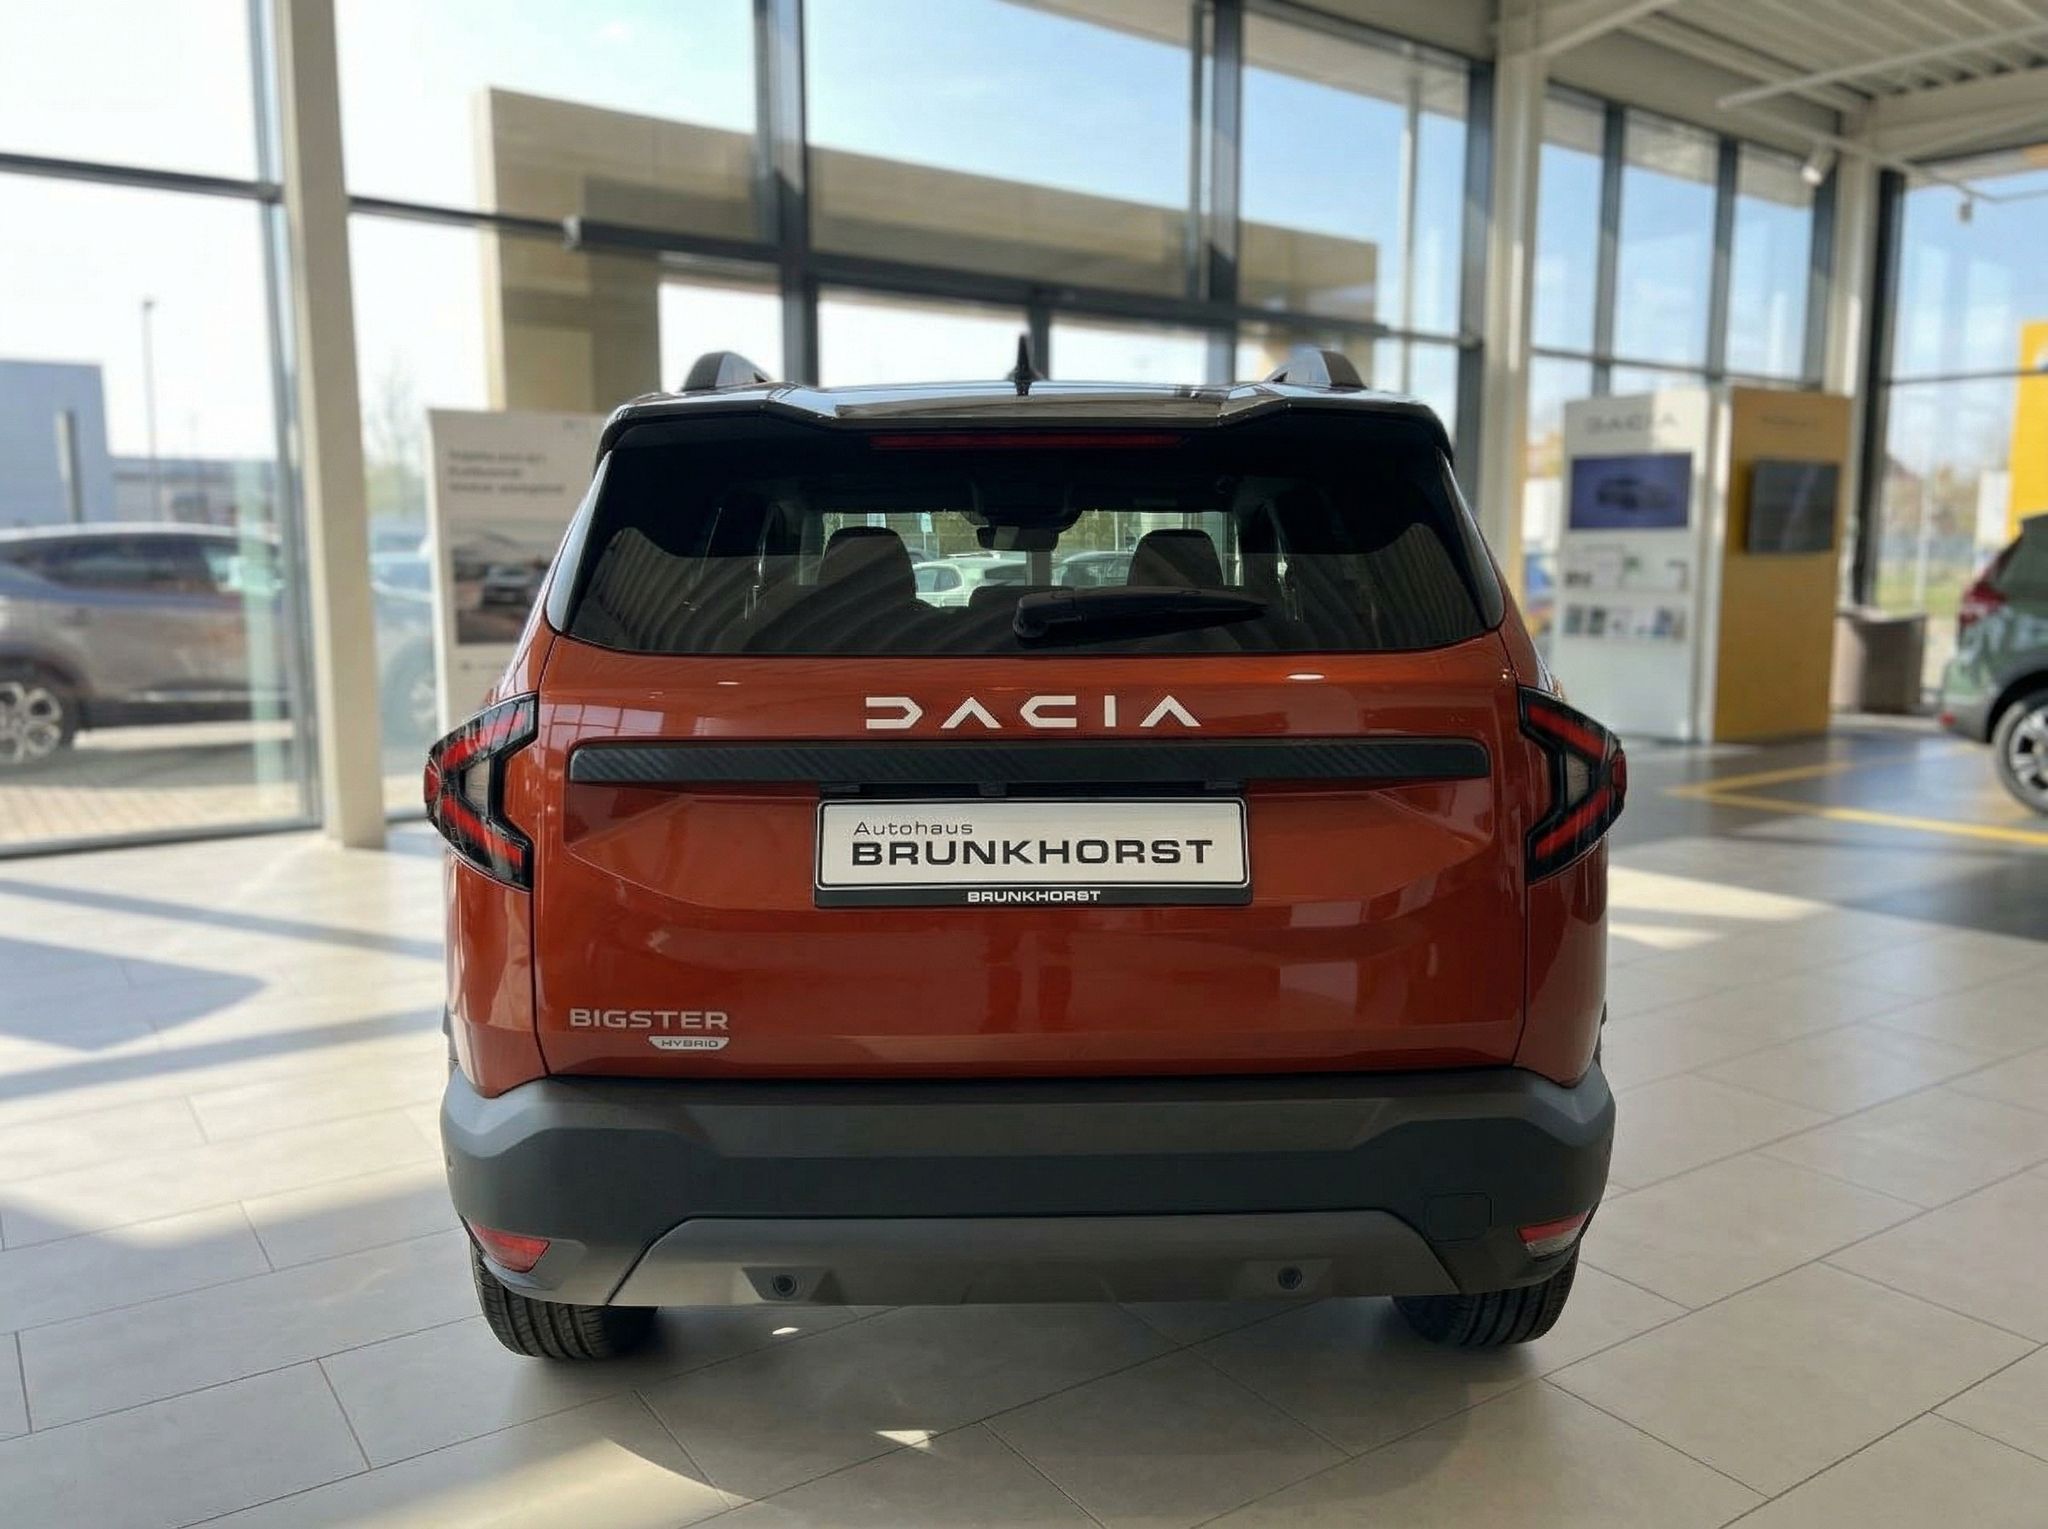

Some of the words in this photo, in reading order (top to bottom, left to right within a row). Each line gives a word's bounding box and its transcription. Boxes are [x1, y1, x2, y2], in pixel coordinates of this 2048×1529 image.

[865, 694, 1202, 730] DACIA
[853, 821, 974, 836] Autohaus
[851, 839, 1214, 867] BRUNKHORST
[967, 890, 1101, 903] BRUNKHORST
[569, 1007, 730, 1030] BIGSTER
[661, 1038, 719, 1048] HYBRID
